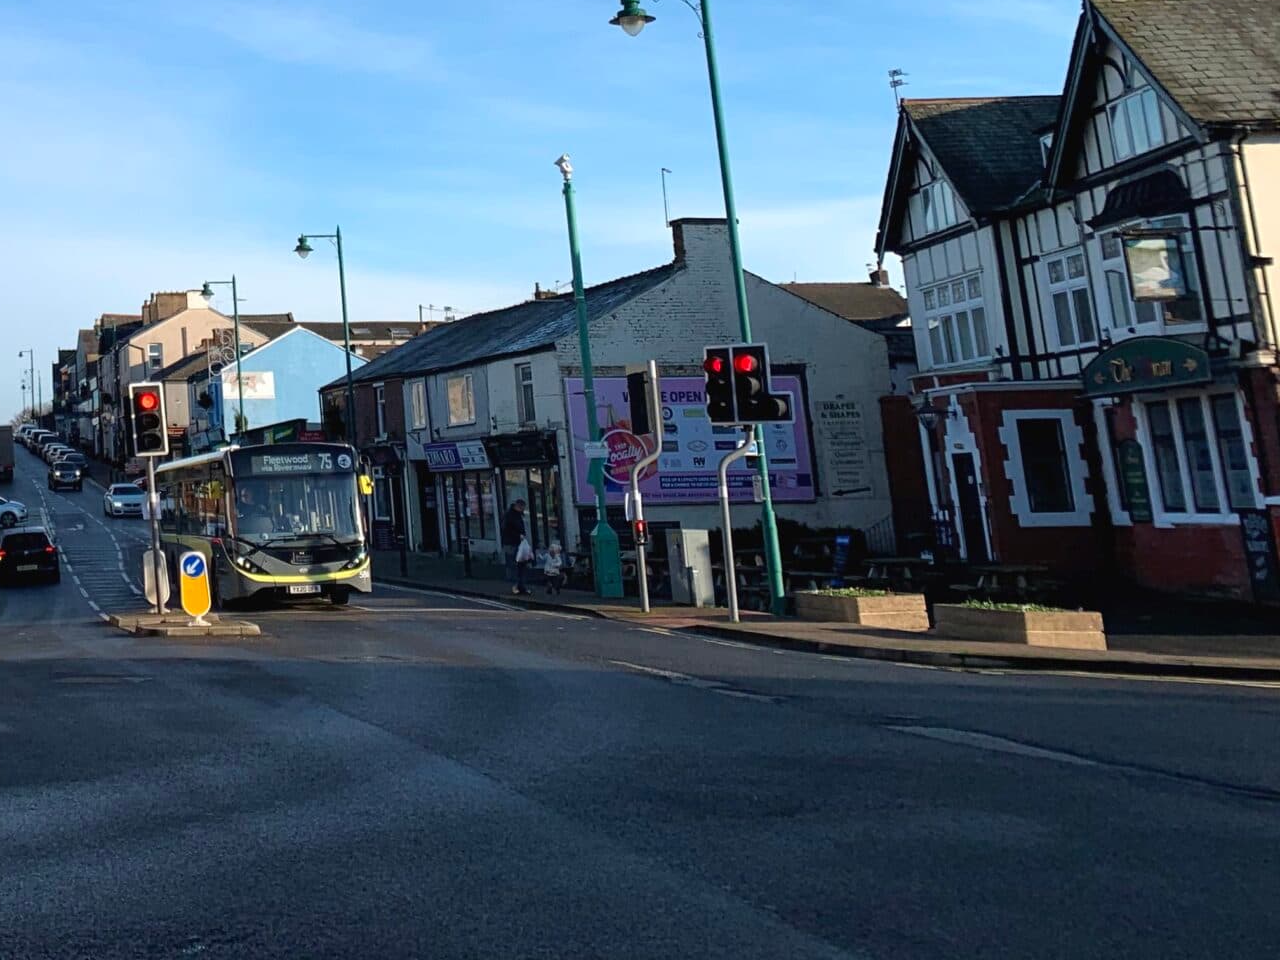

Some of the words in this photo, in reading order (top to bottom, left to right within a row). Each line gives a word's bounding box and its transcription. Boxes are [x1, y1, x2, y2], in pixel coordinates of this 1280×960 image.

[670, 391, 702, 403] OPEN
[263, 454, 308, 465] Fleetwood
[318, 452, 332, 470] 75
